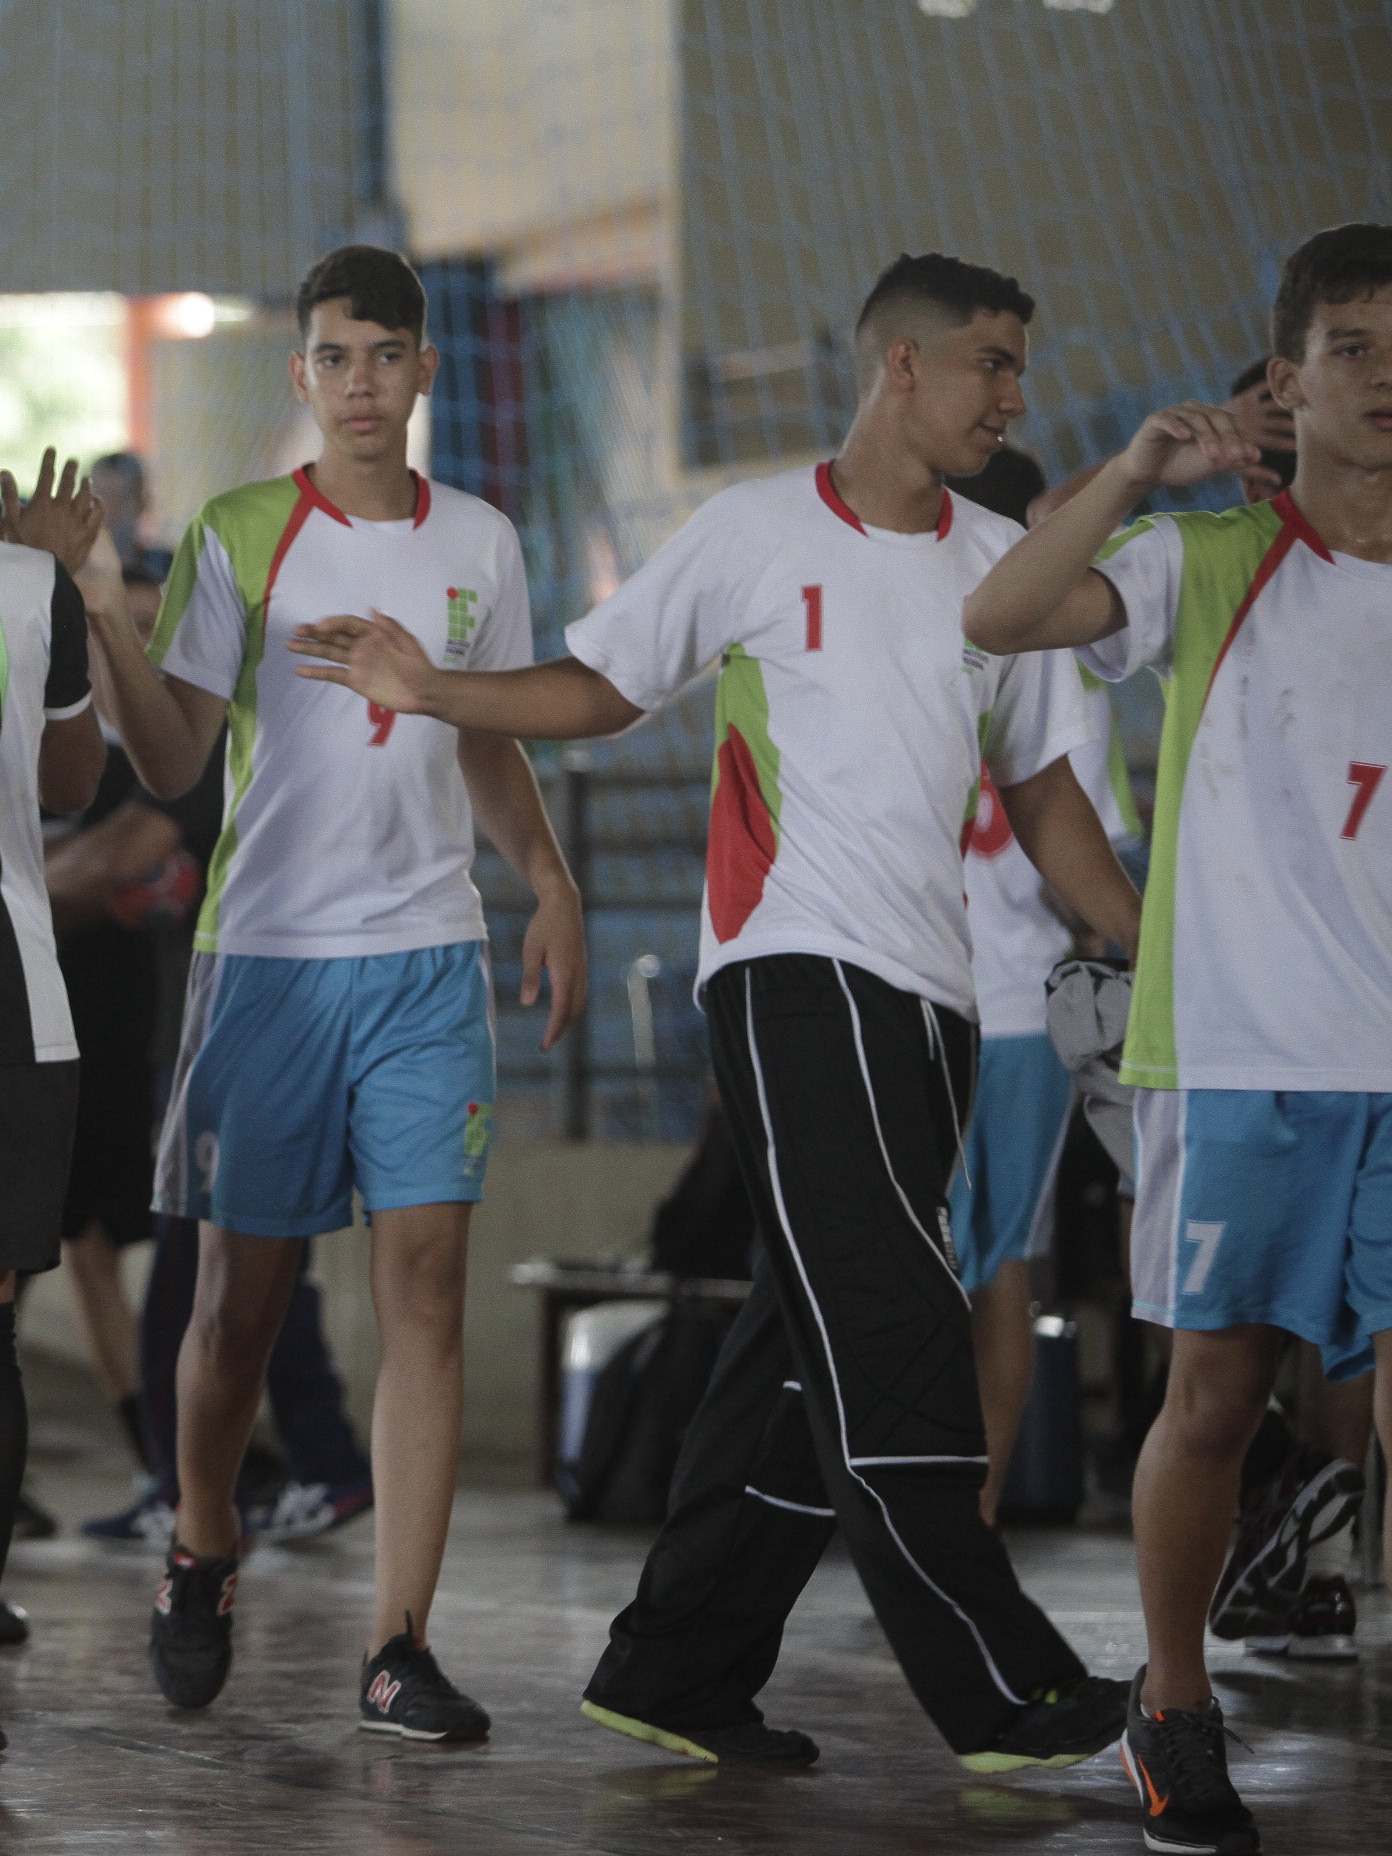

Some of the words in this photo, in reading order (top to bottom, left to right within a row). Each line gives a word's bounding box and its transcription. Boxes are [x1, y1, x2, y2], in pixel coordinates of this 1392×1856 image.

[801, 584, 823, 652] 1
[1340, 761, 1388, 841] 7
[1181, 1219, 1226, 1295] 7
[367, 1670, 402, 1714] N
